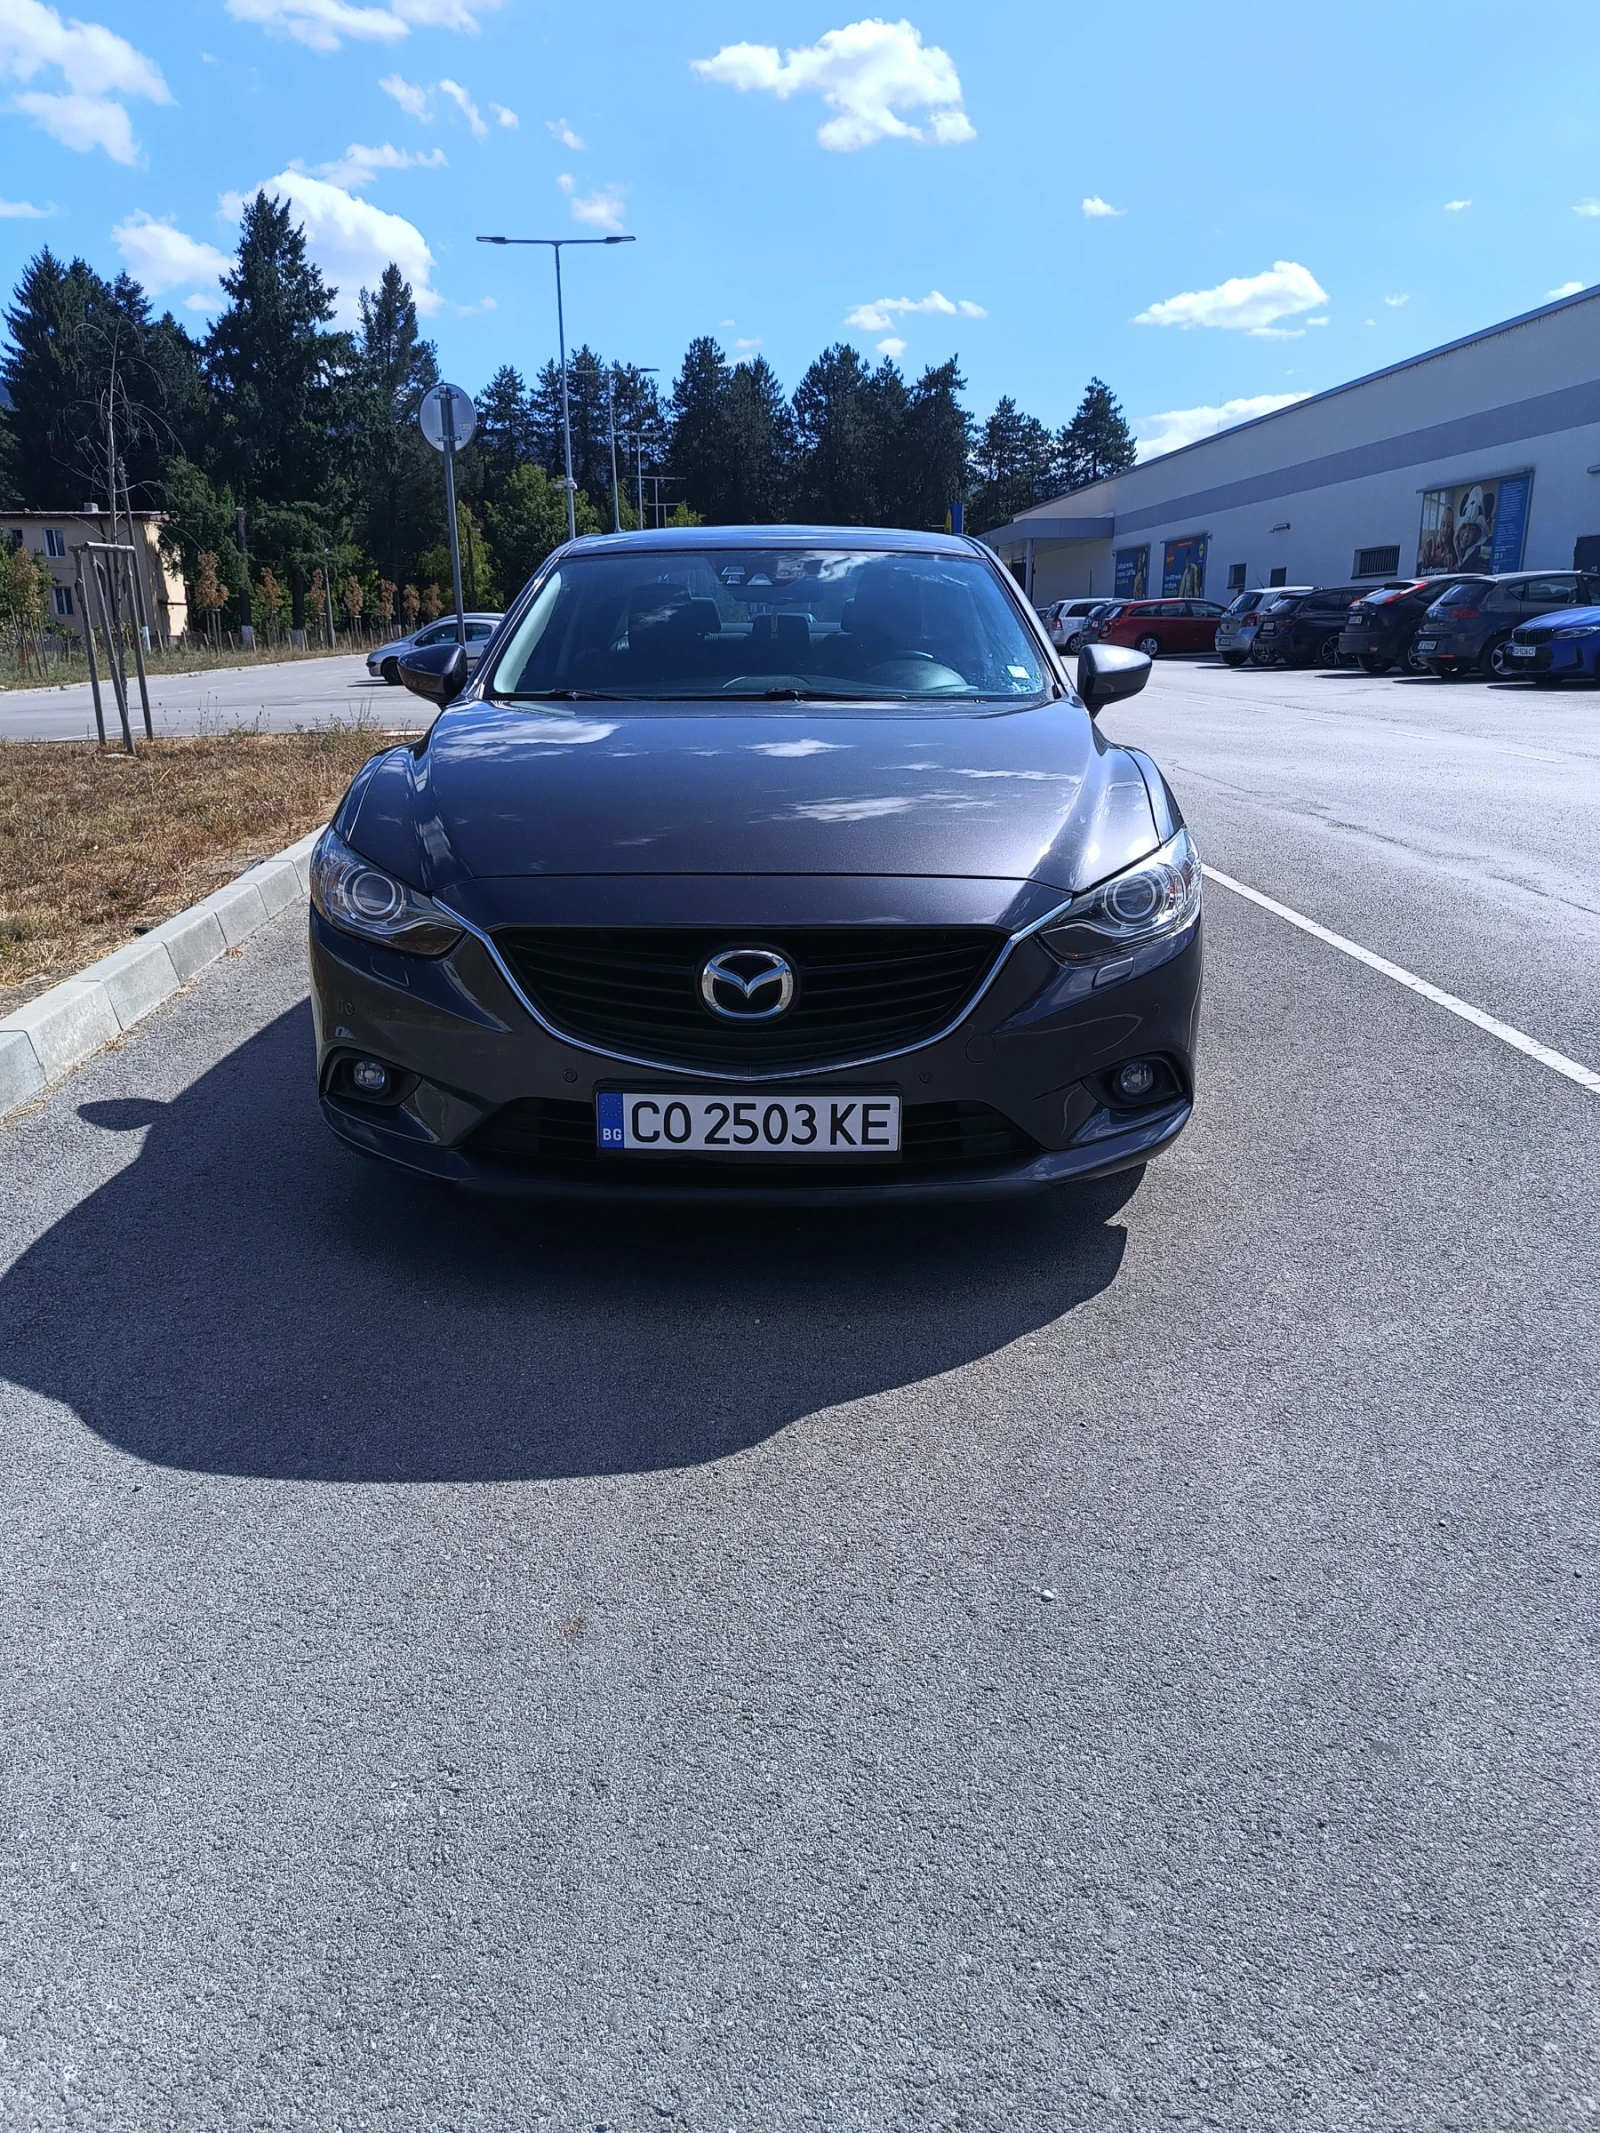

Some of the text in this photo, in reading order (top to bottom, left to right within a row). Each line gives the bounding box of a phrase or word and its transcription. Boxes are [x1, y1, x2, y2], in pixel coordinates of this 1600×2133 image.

[602, 1128, 622, 1141] BG
[631, 1101, 891, 1146] CO 2503 KE
